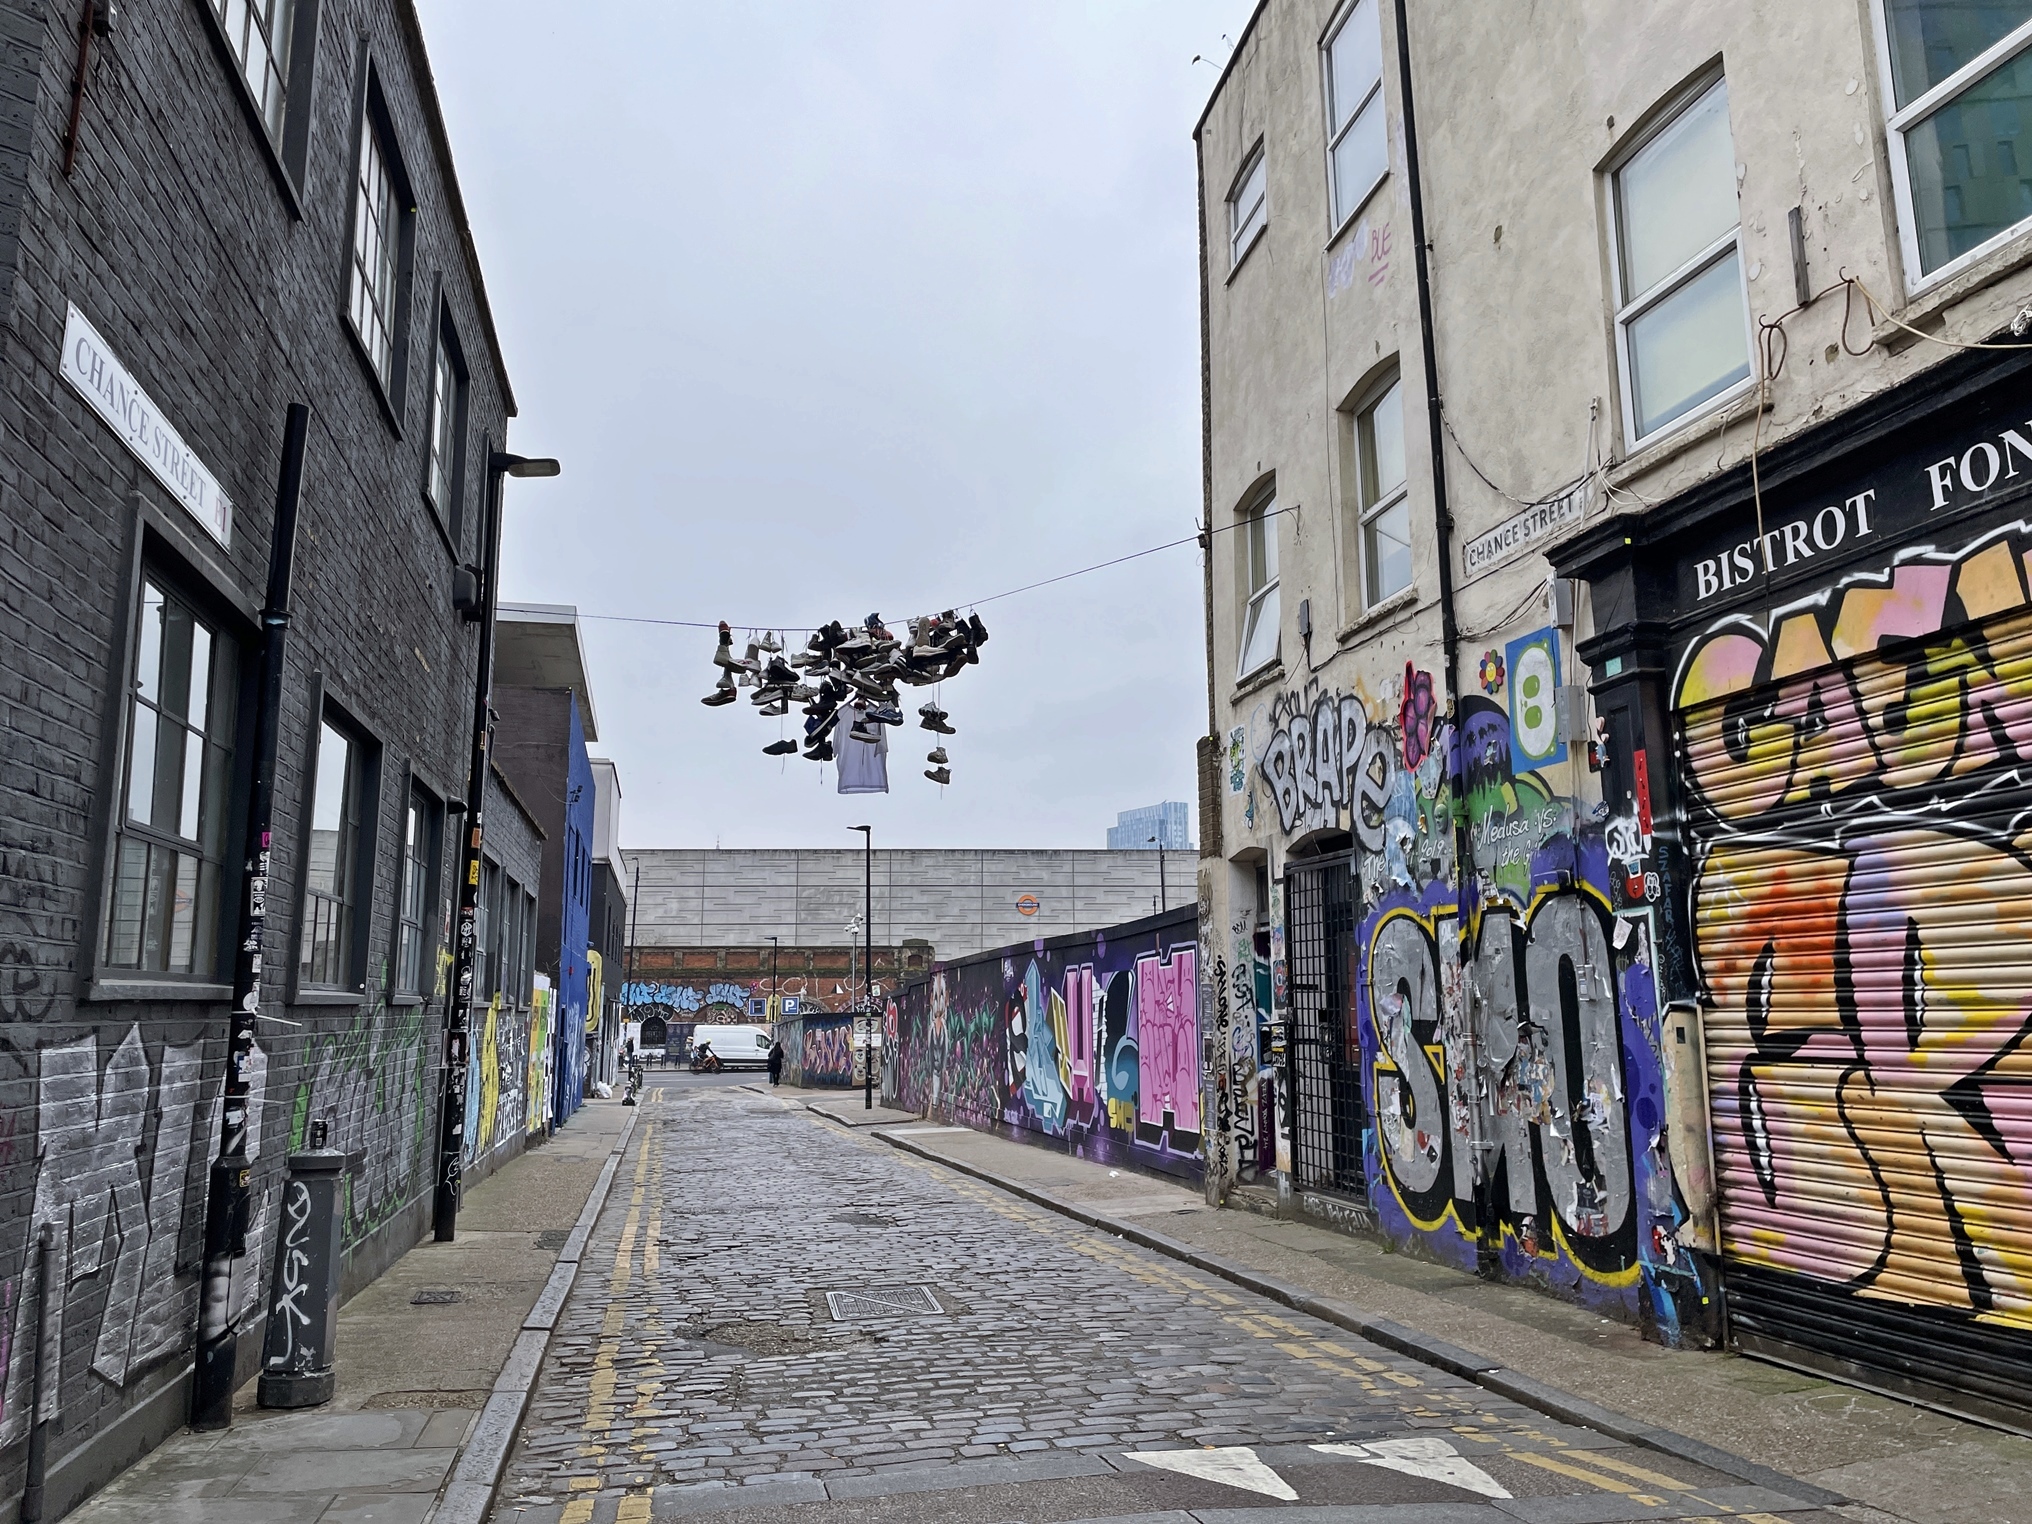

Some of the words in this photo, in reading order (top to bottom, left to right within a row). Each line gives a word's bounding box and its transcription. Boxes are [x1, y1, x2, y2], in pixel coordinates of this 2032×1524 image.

[75, 337, 149, 445] CHANCE
[152, 426, 207, 508] STREET
[214, 495, 227, 534] E1
[1469, 524, 1519, 567] CHANCE
[1522, 495, 1574, 538] STREET
[1693, 489, 1877, 601] BISTROT
[1477, 802, 1530, 851] Medusa
[1501, 841, 1520, 867] the
[785, 999, 795, 1012] P
